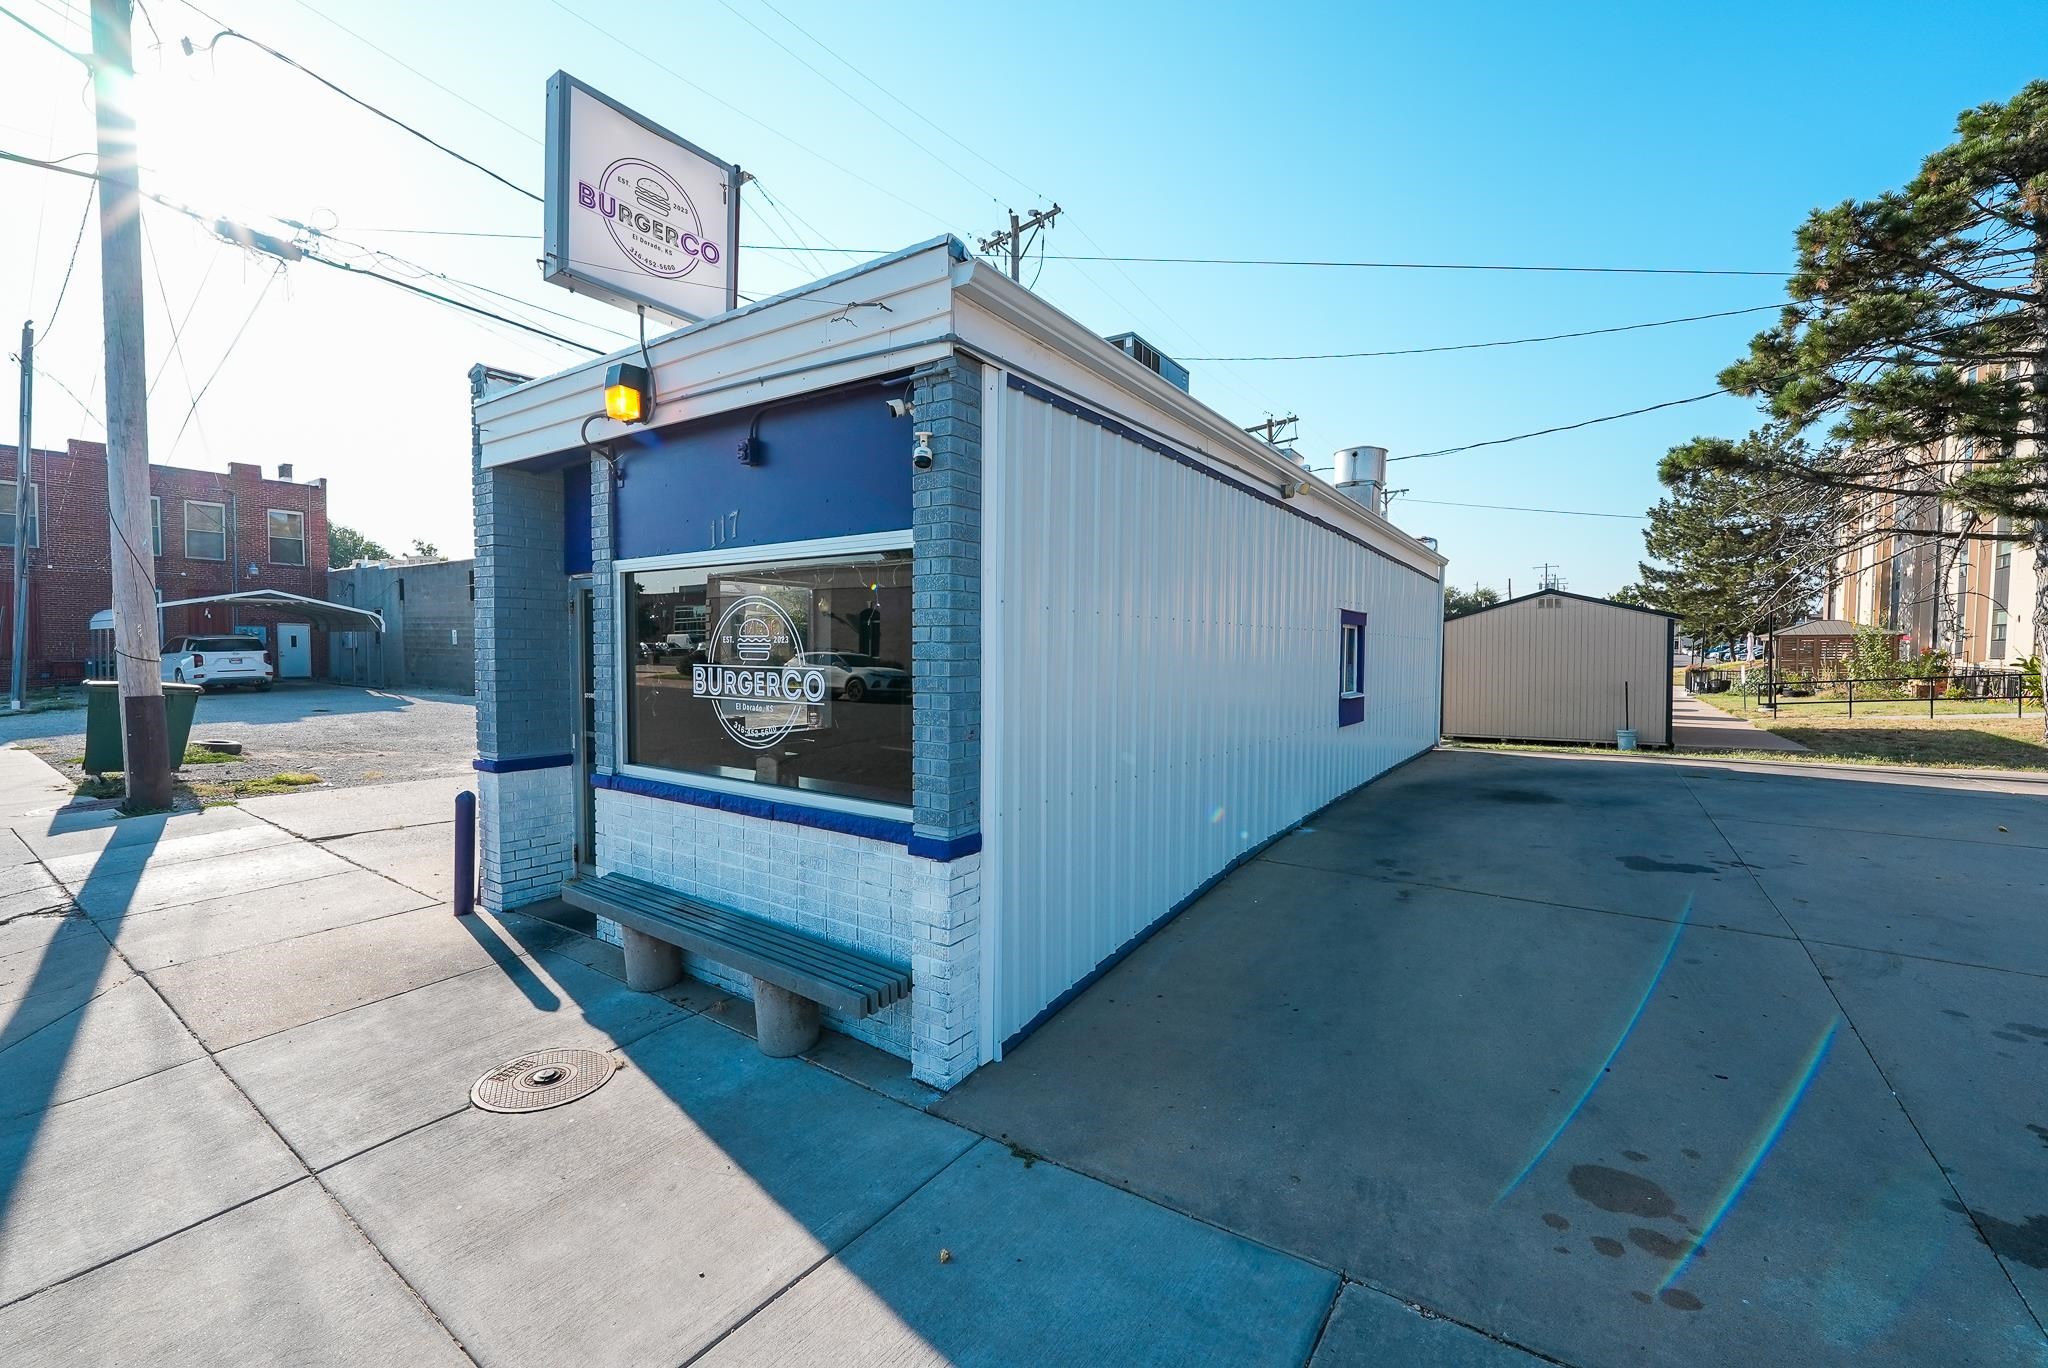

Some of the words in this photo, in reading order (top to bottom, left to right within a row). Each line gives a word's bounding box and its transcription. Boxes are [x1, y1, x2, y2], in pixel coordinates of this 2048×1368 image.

[617, 175, 632, 188] EST.
[673, 203, 689, 215] 2023
[578, 181, 720, 265] BURGERCO
[632, 233, 638, 241] El
[664, 248, 673, 256] KS
[710, 508, 740, 549] 117
[722, 635, 735, 644] EST.
[773, 635, 789, 644] 2023
[692, 666, 826, 703] BURGERCO
[735, 702, 741, 710] El
[765, 704, 774, 713] KS
